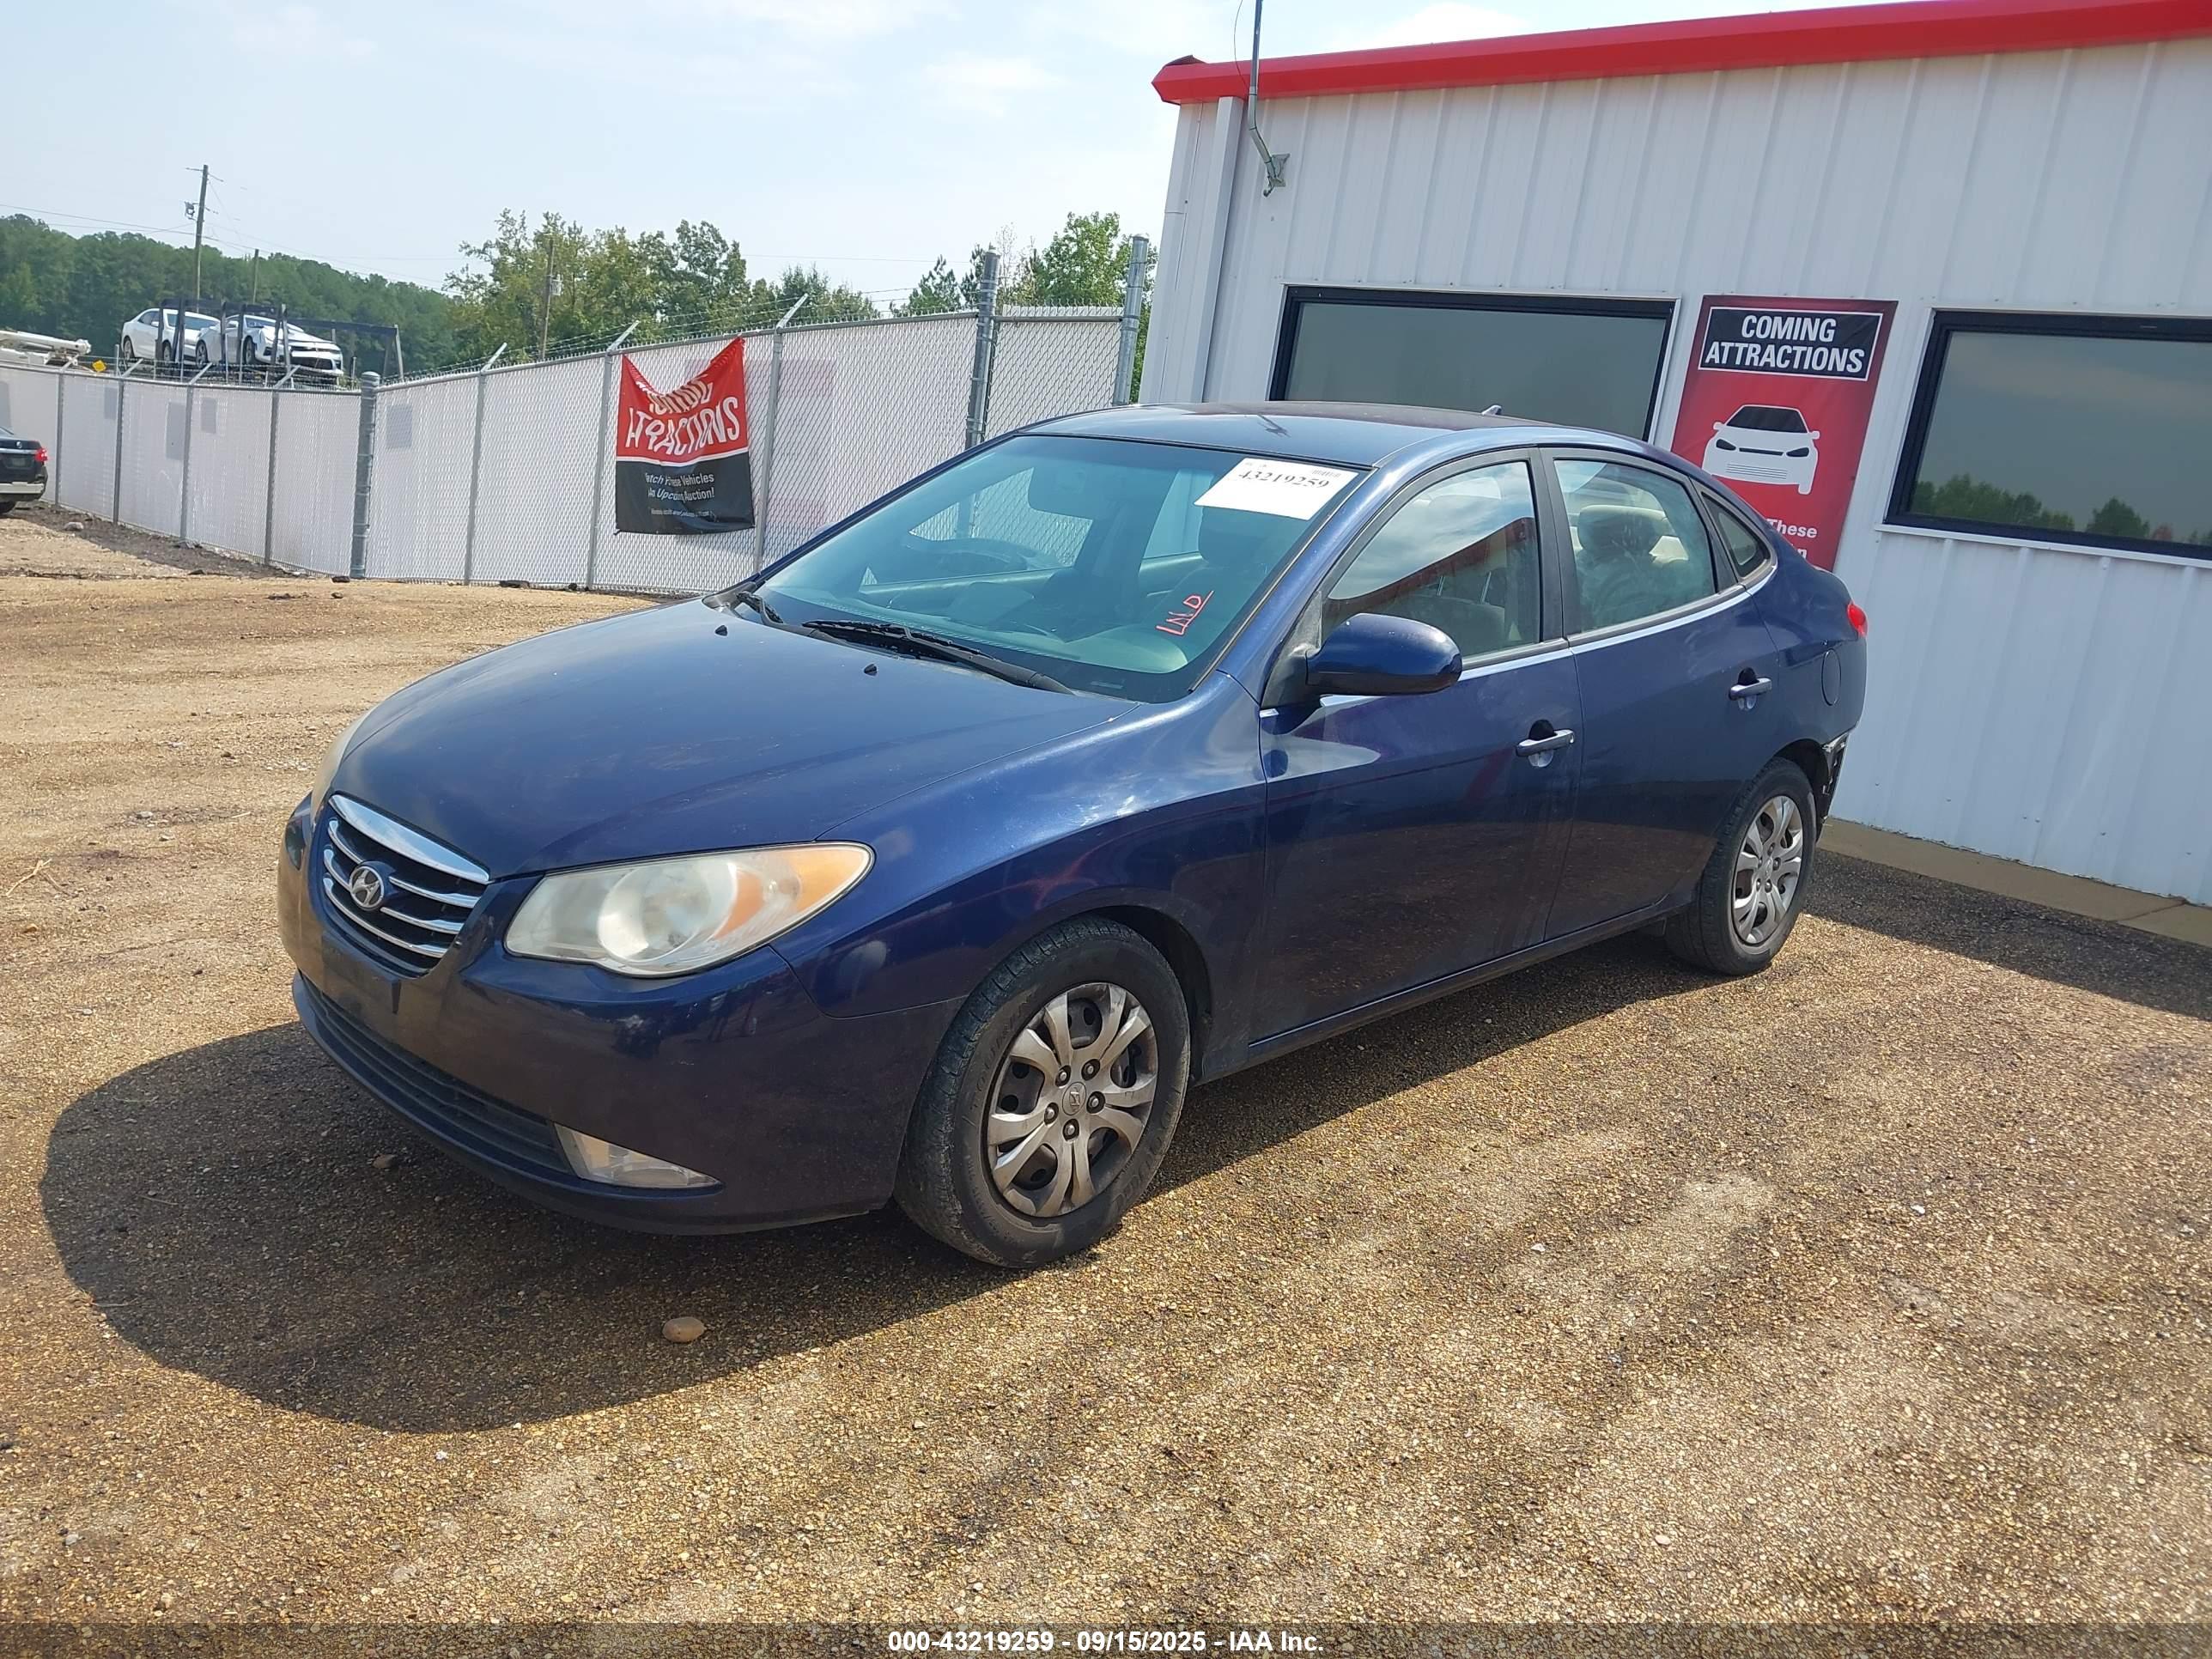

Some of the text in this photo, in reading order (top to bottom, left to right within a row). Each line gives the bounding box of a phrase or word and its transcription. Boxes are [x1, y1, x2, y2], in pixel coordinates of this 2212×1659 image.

[1741, 314, 1837, 343] COMING
[1705, 341, 1865, 373] ATTRACTIONS
[680, 472, 714, 487] Vehicles
[1238, 470, 1330, 489] 43219259
